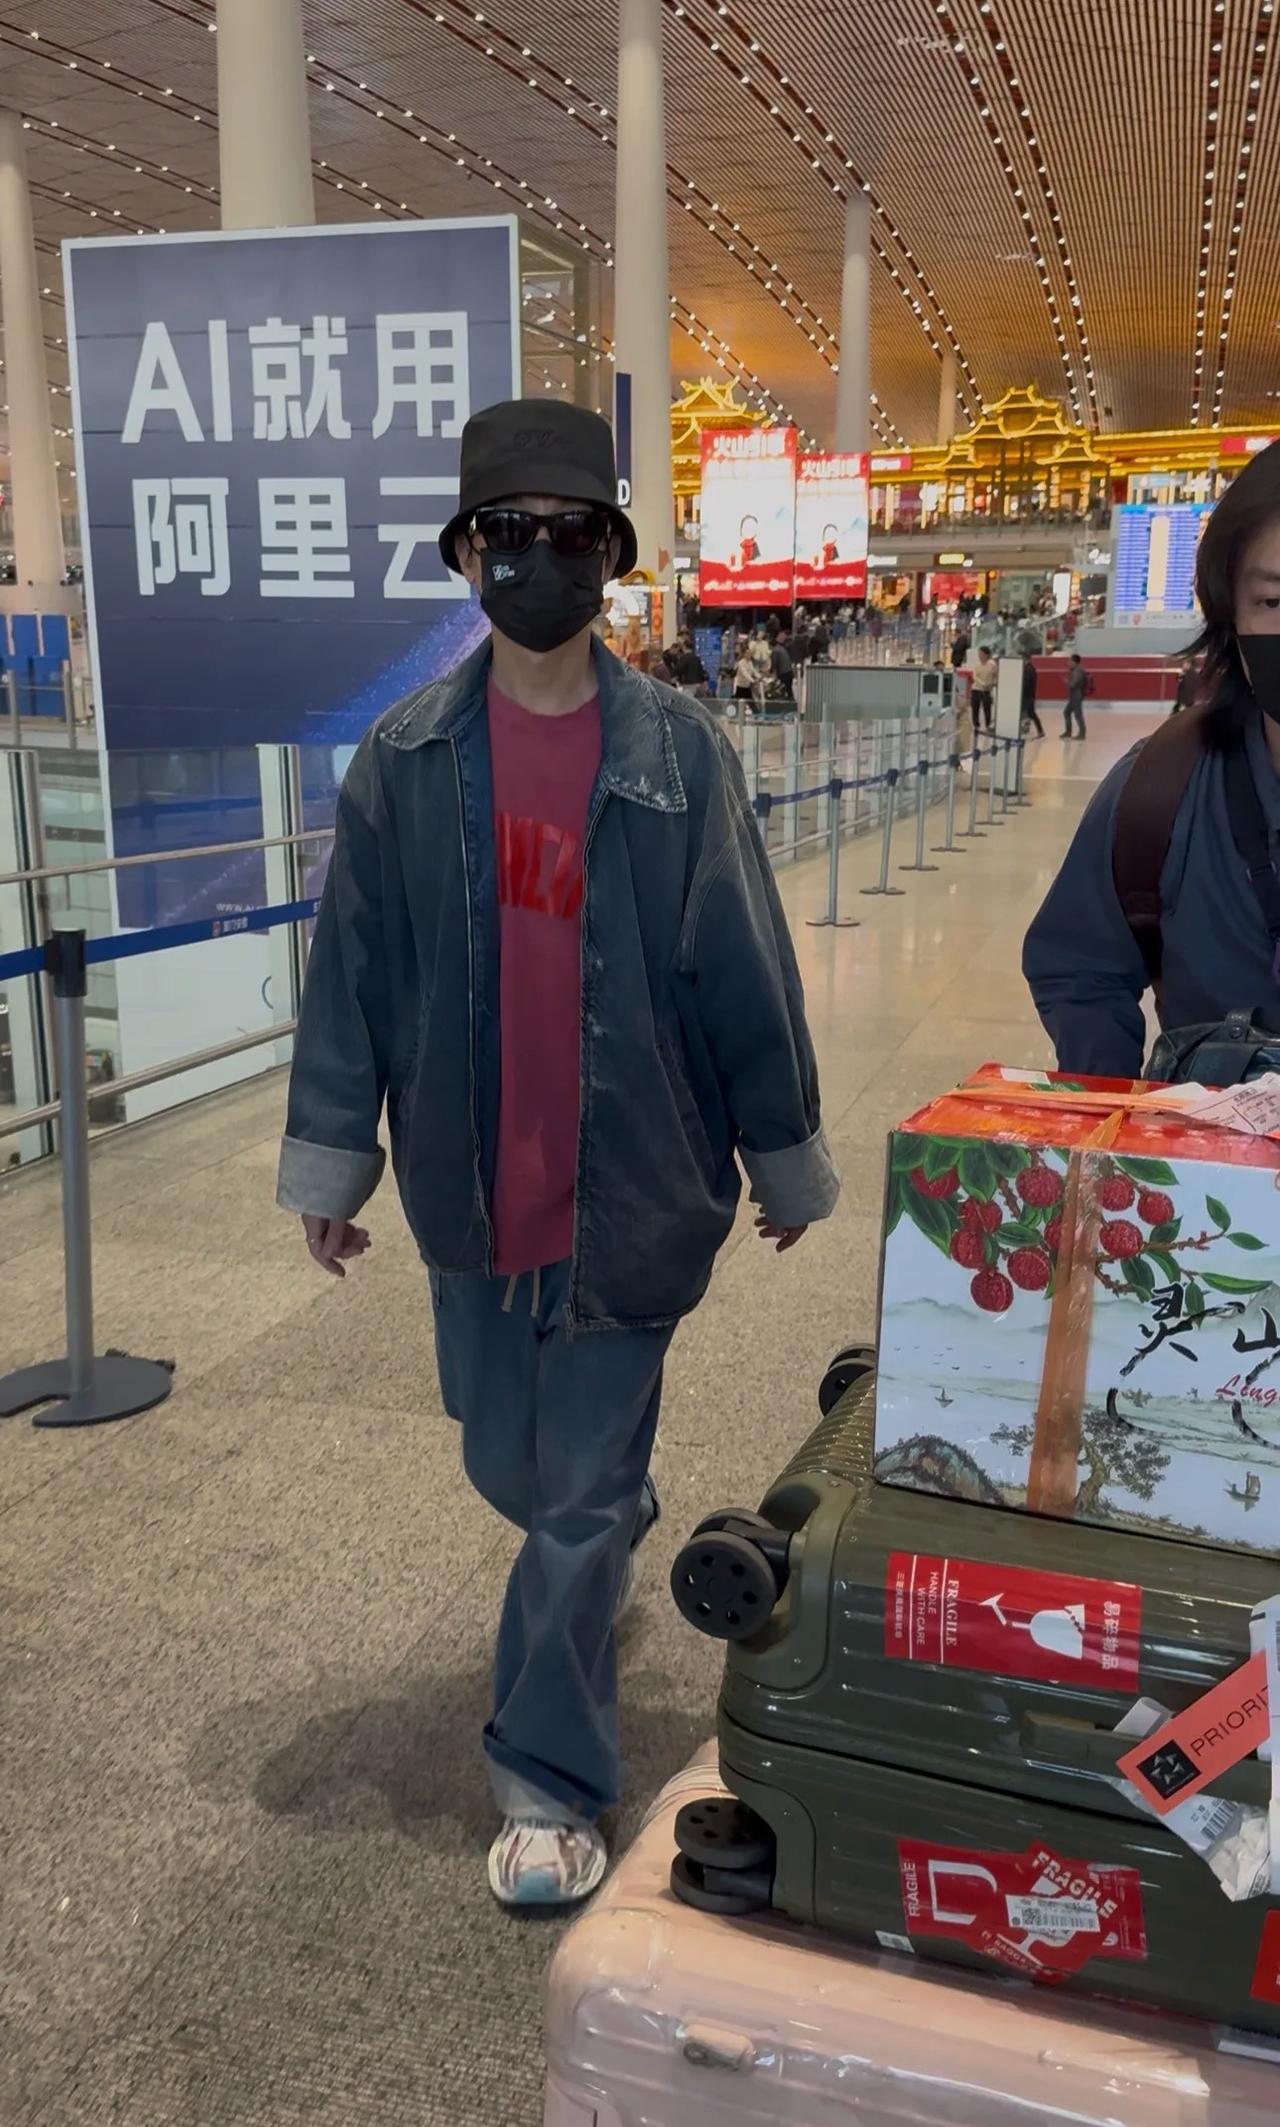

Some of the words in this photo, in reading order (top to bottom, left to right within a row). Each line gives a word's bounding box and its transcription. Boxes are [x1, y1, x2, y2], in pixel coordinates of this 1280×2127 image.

[121, 311, 470, 444] AI就用
[131, 477, 471, 600] 阿里云
[917, 1586, 927, 1615] WITH
[927, 1571, 940, 1615] HANDLE
[945, 1579, 960, 1647] FRAGILE
[915, 1616, 926, 1646] CARE
[1101, 1600, 1121, 1670] 易碎物品
[903, 1862, 921, 1917] FRAGILE
